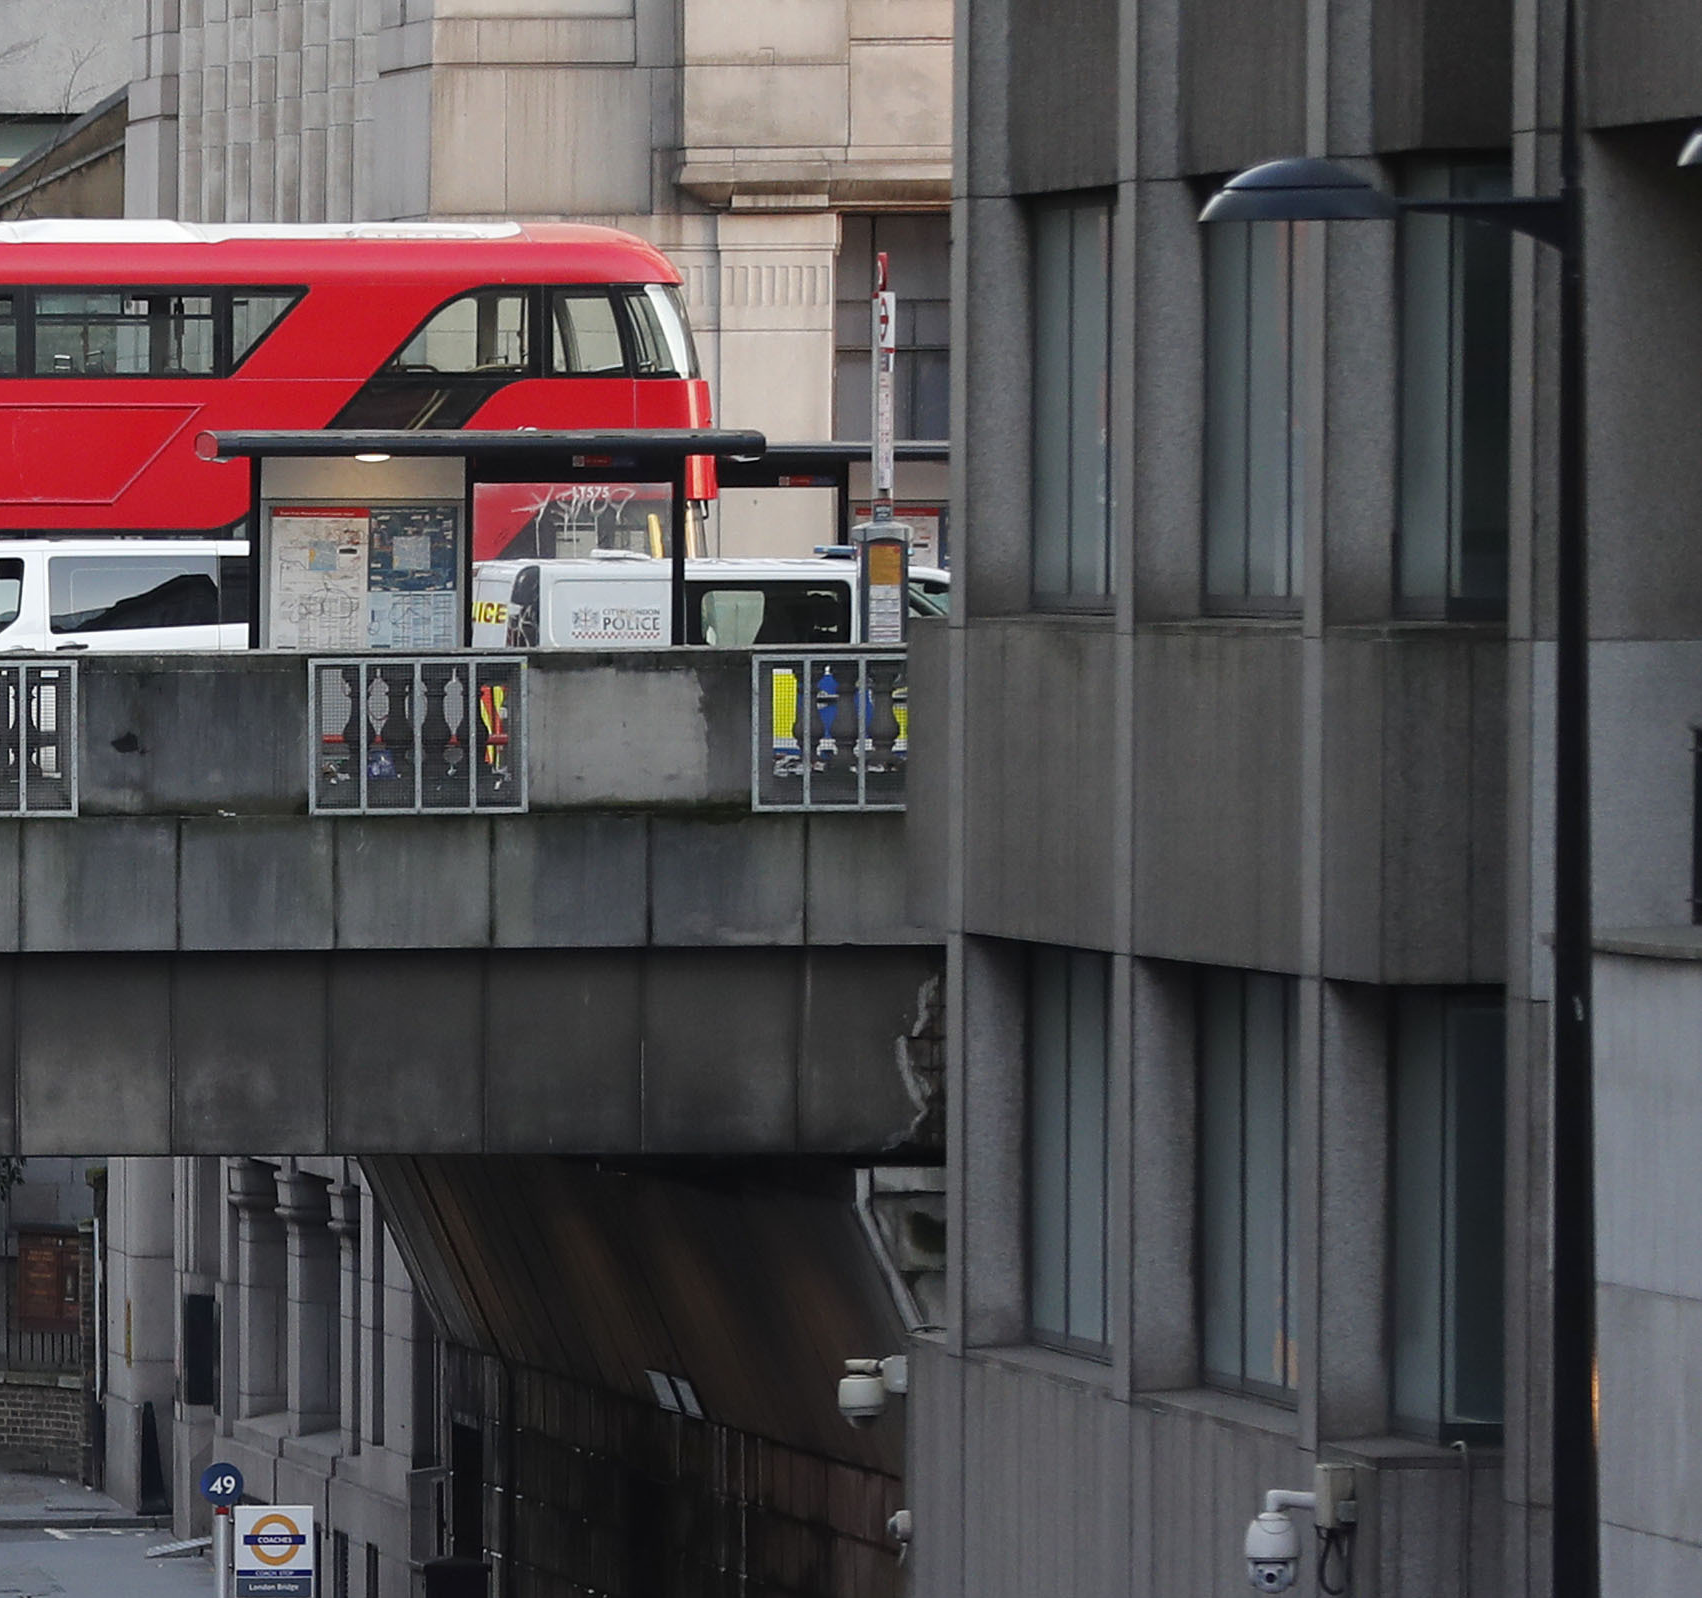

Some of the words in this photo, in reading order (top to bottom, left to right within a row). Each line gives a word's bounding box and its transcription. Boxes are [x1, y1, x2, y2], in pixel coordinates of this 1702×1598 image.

[472, 602, 507, 624] LICE
[603, 616, 661, 631] POLICE
[209, 1475, 236, 1494] 49
[249, 1583, 276, 1591] London
[277, 1583, 299, 1592] Bridge
